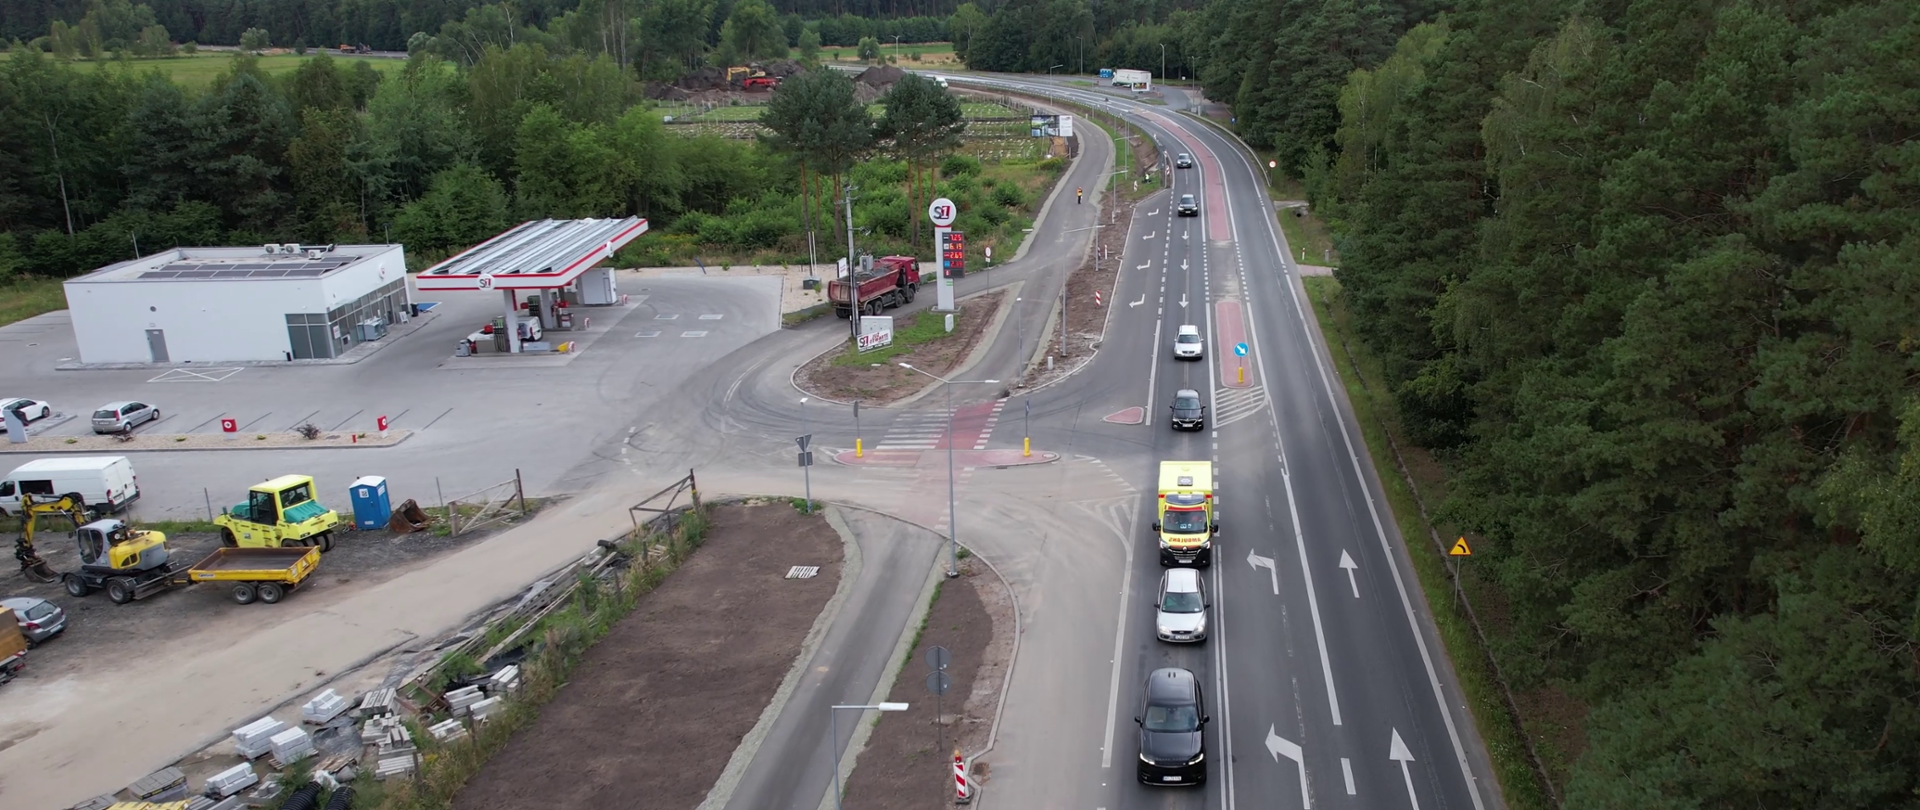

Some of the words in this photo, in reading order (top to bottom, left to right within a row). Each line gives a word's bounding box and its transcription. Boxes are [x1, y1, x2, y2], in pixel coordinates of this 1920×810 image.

[933, 206, 950, 219] S1
[479, 278, 491, 288] S1
[859, 335, 869, 348] S1
